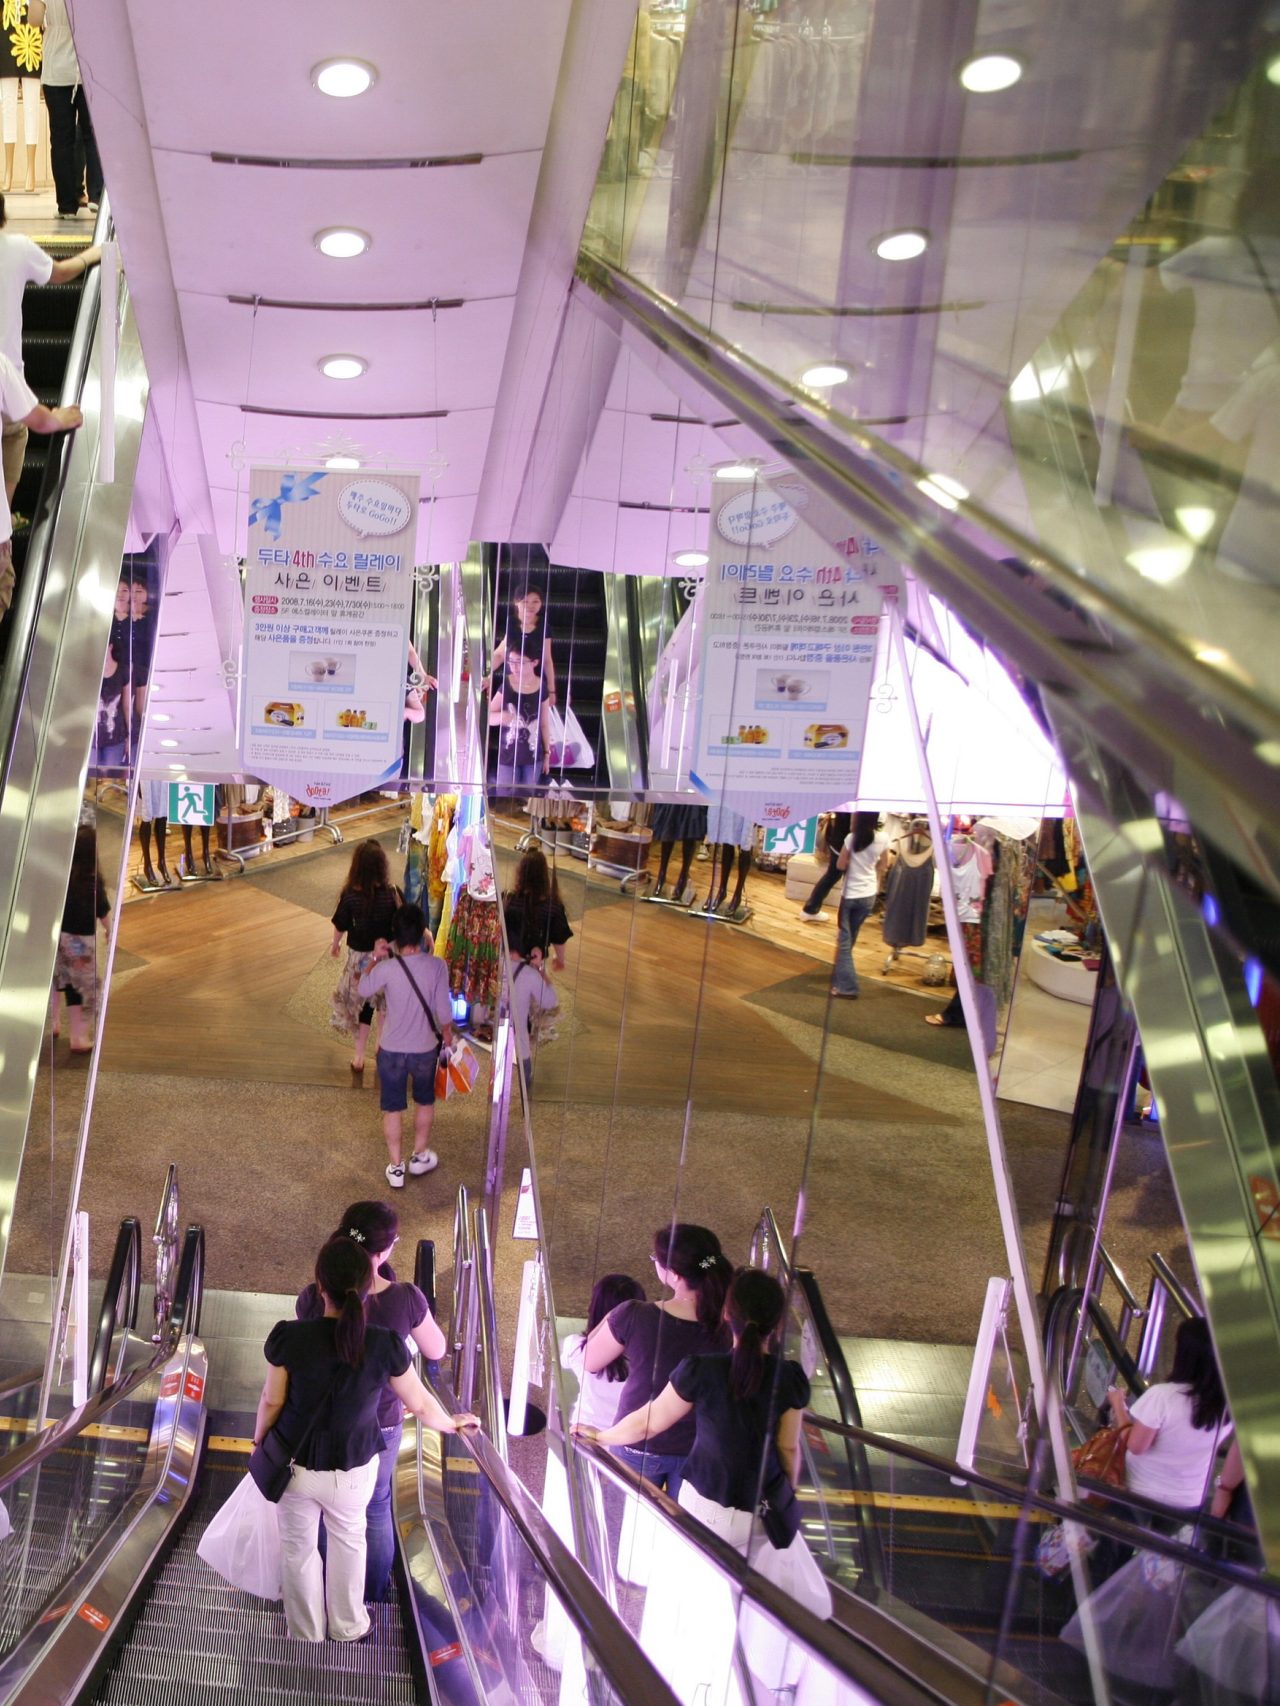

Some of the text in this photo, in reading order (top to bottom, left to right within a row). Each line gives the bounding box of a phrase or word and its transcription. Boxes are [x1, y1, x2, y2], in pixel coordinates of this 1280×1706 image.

[350, 490, 364, 502] 매주
[258, 548, 401, 571] 두타 4th 수요 릴레이
[276, 624, 290, 633] 이상
